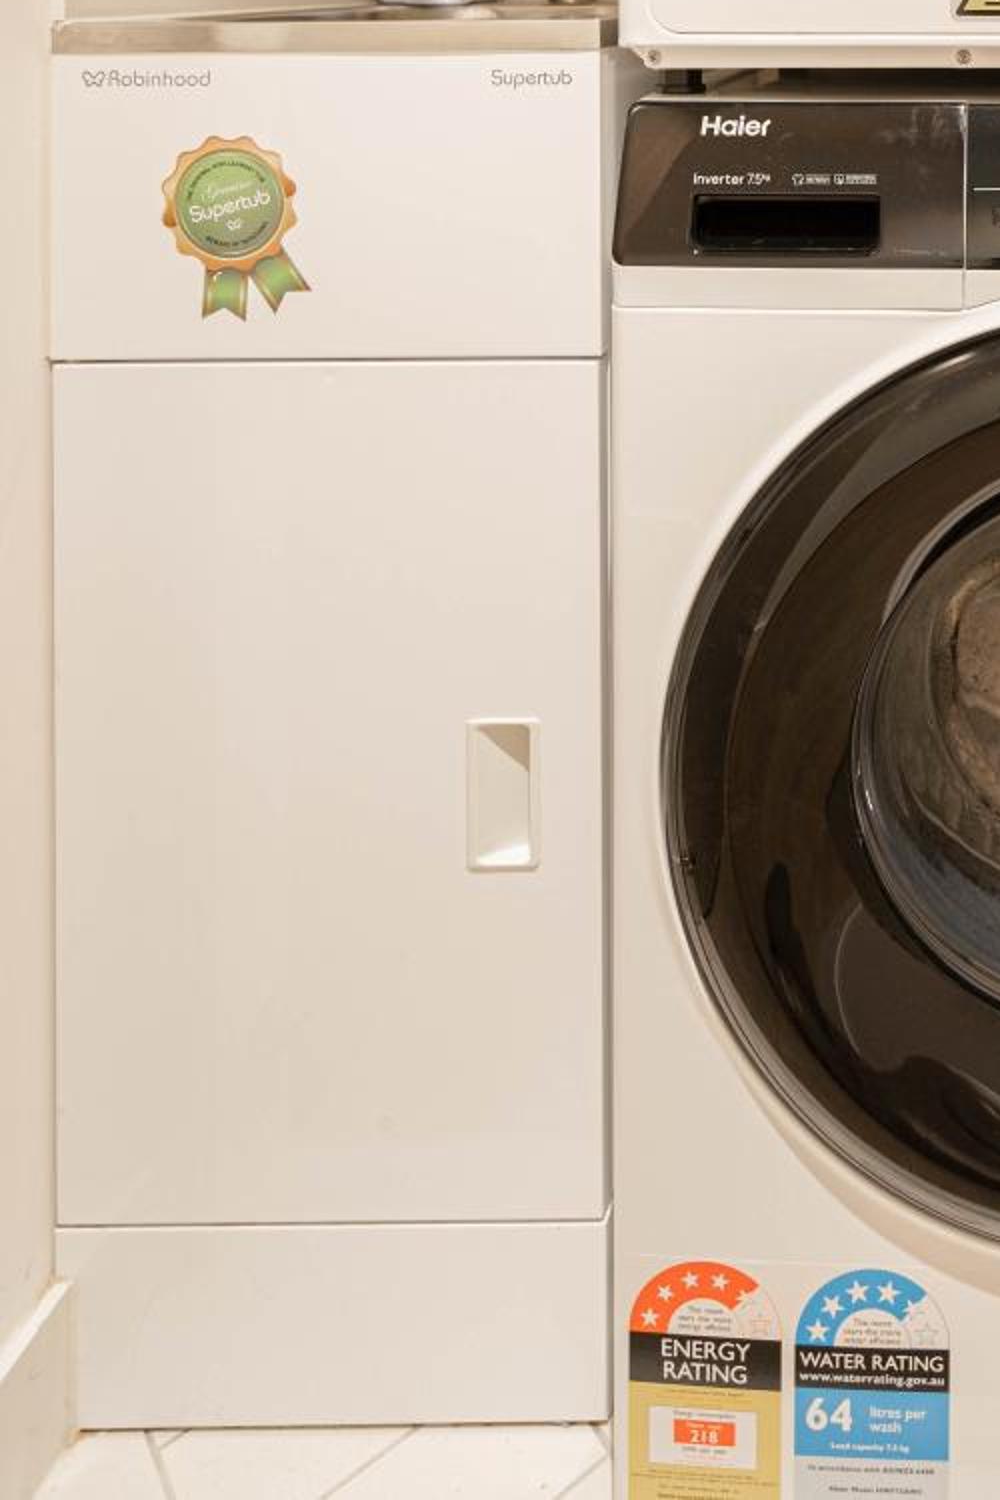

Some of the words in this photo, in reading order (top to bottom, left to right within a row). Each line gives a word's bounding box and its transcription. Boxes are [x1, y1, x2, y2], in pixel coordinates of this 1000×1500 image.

[108, 69, 210, 88] Robinhood
[490, 69, 573, 89] Supertub
[699, 115, 772, 136] Haier
[693, 172, 744, 185] Inverter
[189, 189, 271, 223] Supertub
[661, 1338, 751, 1362] ENERGY
[799, 1350, 866, 1370] WATER
[871, 1354, 944, 1373] RATING
[663, 1361, 748, 1384] RATING
[799, 1372, 945, 1388] www.waterrating.gov.au
[805, 1396, 853, 1432] 64
[868, 1405, 903, 1420] litres
[905, 1408, 927, 1423] per
[868, 1421, 902, 1434] wash
